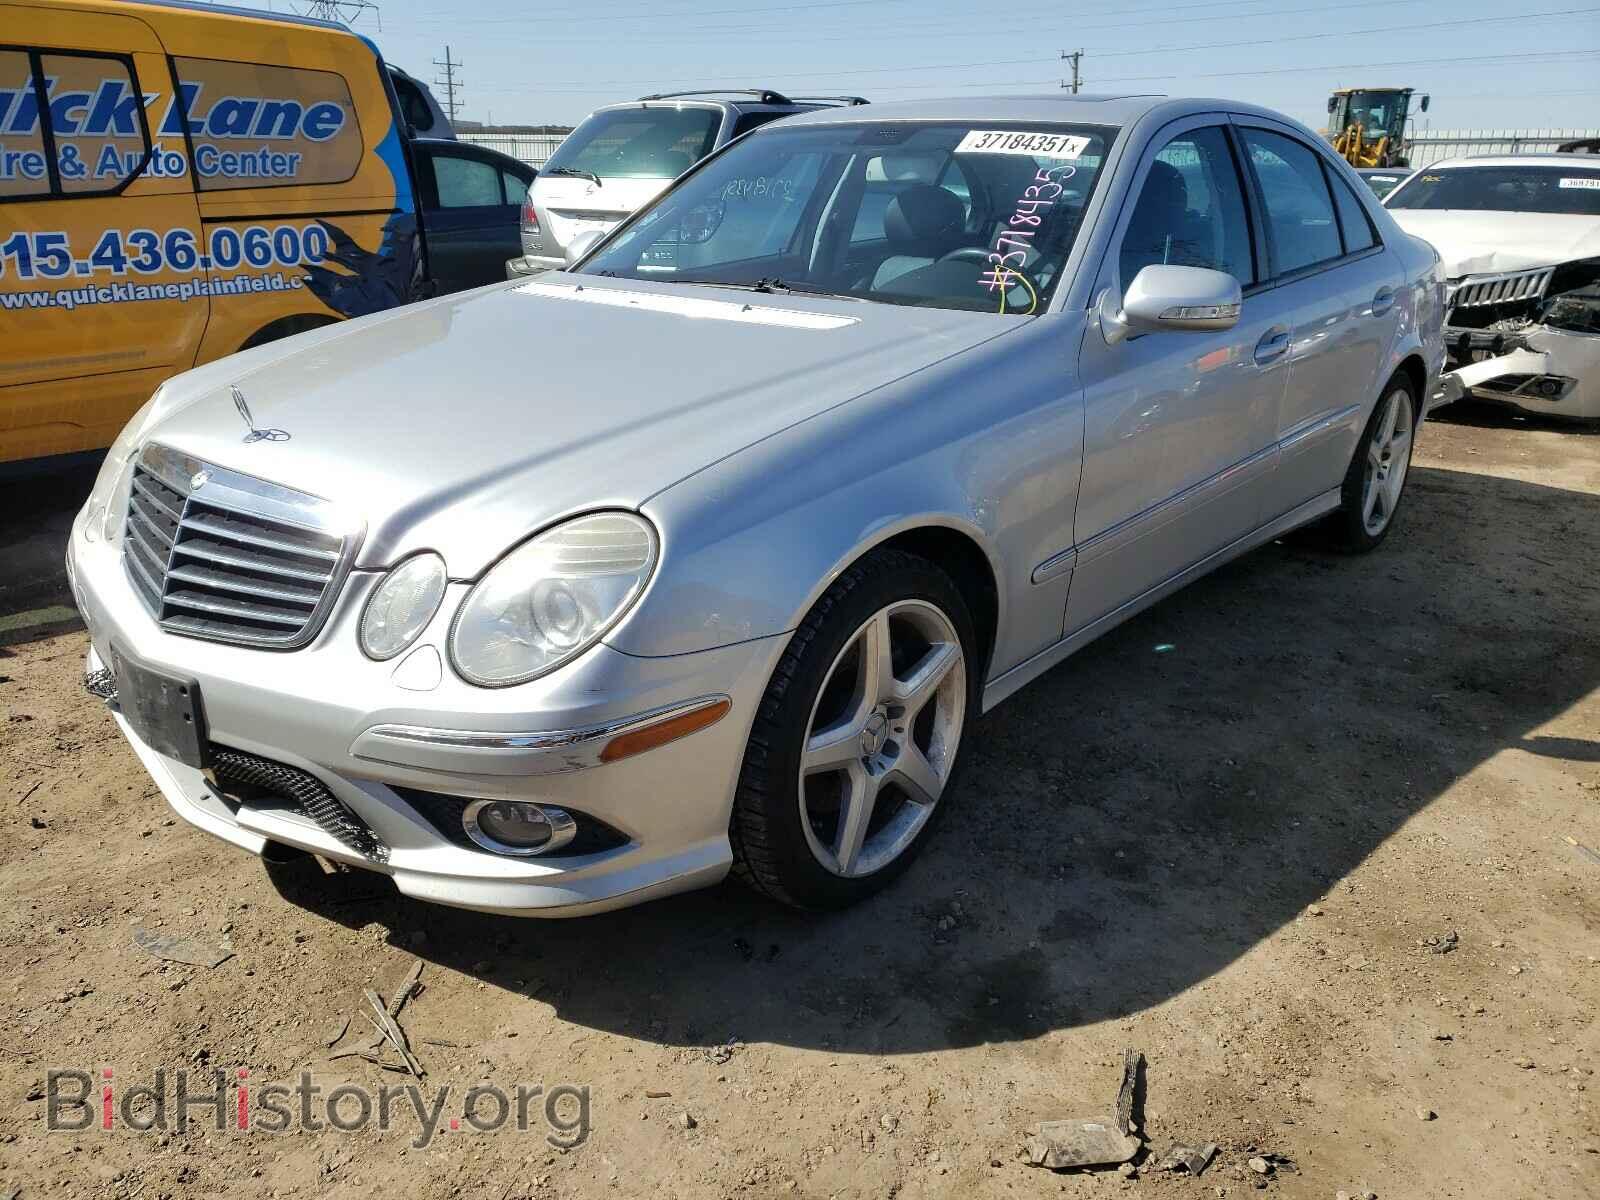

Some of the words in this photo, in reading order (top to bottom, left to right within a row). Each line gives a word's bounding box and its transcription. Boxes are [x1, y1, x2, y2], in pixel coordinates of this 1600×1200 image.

[157, 80, 347, 142] Lane
[58, 142, 89, 180] &
[94, 143, 187, 179] Auto
[195, 144, 302, 178] Center
[0, 224, 329, 280] 15.436.0600
